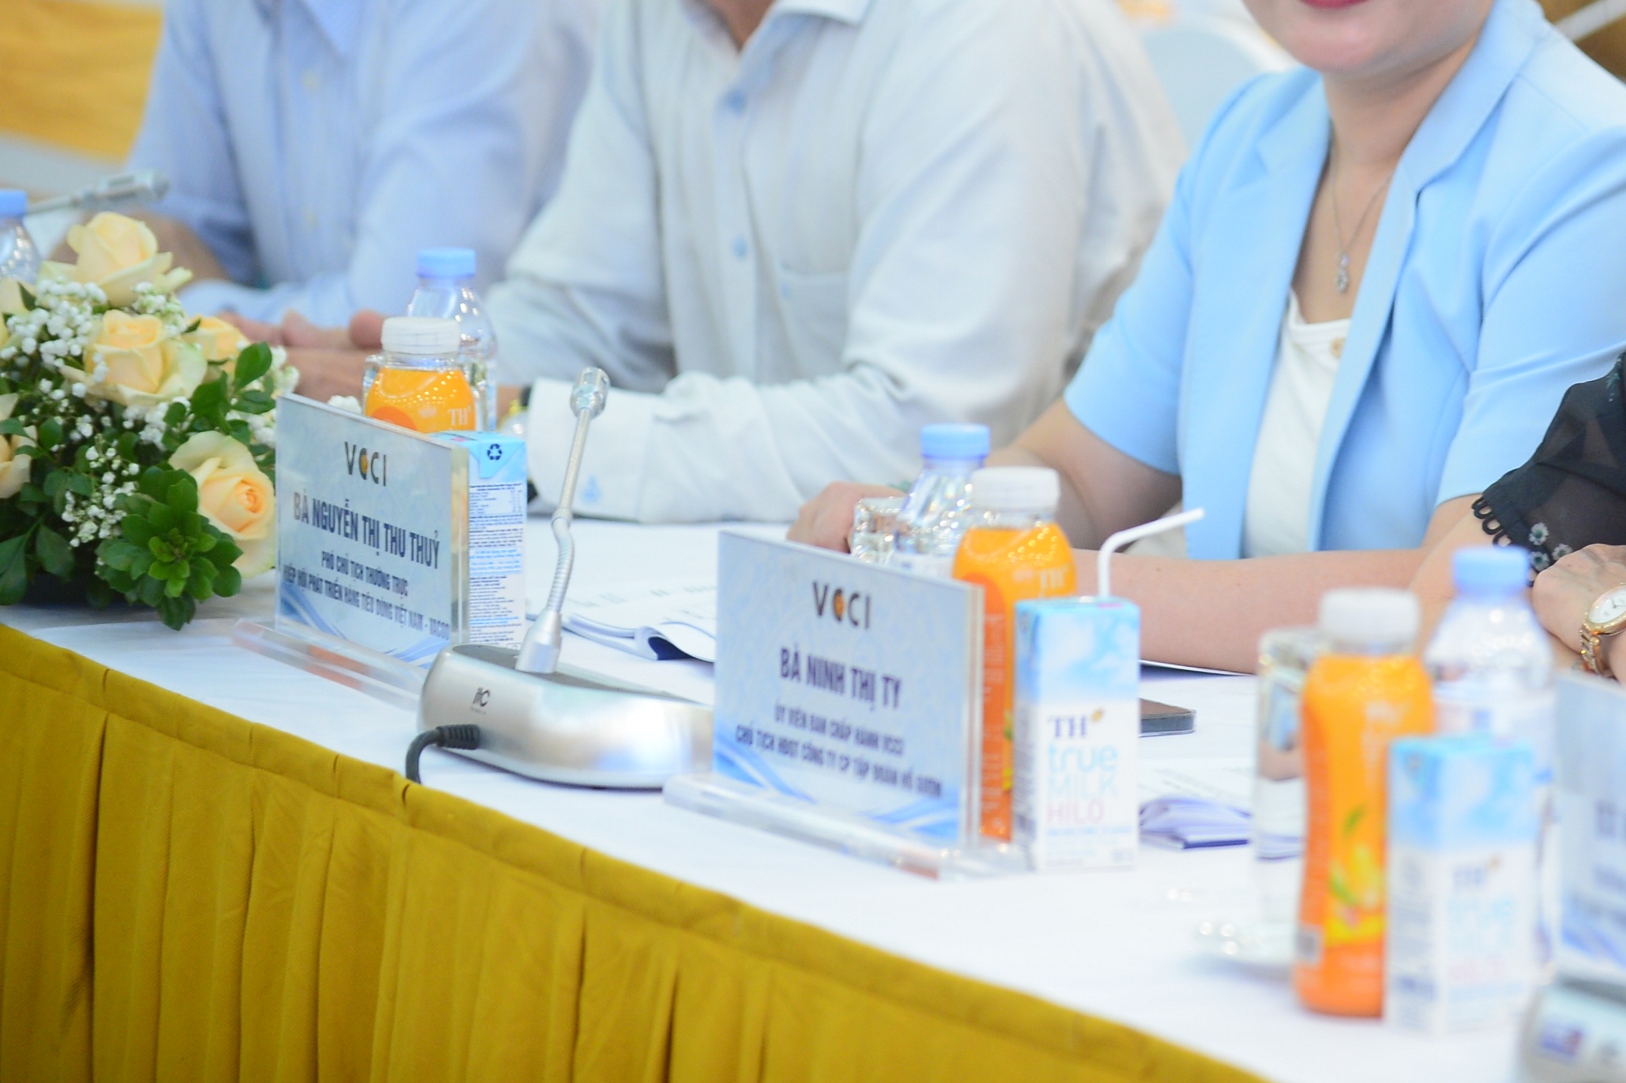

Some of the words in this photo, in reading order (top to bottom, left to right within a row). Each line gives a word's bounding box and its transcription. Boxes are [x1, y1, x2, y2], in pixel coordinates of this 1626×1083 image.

[294, 489, 309, 524] BÀ
[312, 498, 358, 542] NGUYỄN
[362, 515, 380, 556] THỊ
[383, 523, 406, 558] THU
[781, 643, 801, 682] BÀ
[807, 655, 845, 695] NINH
[851, 667, 876, 711] THỊ
[882, 675, 902, 708] TY
[1047, 714, 1088, 739] TH
[1047, 744, 1118, 774] true
